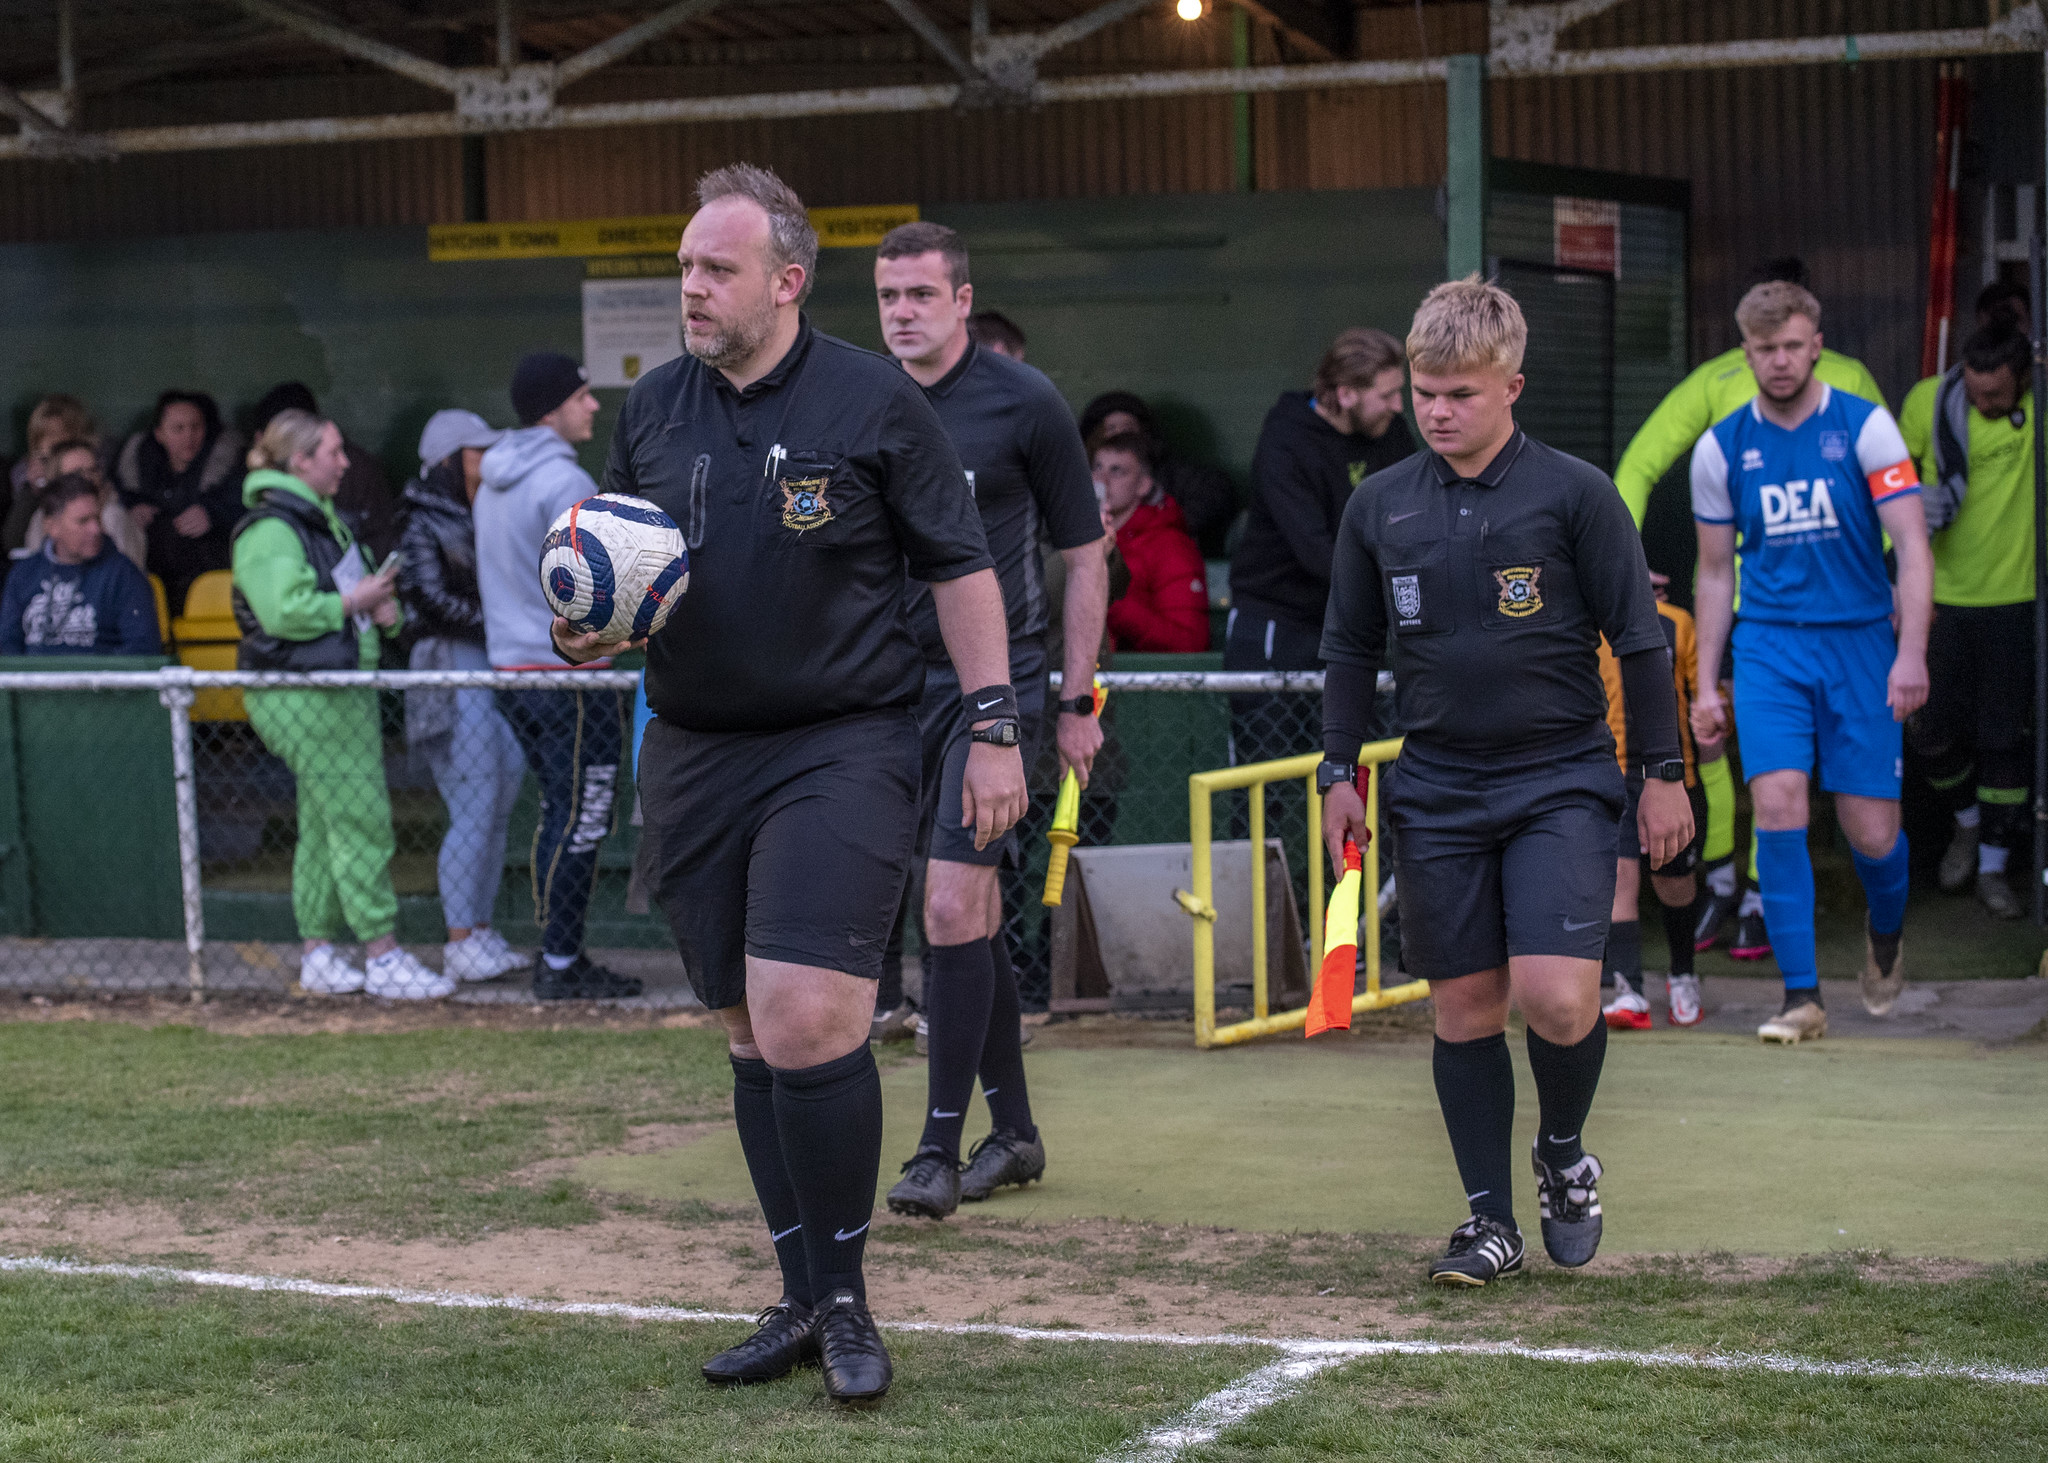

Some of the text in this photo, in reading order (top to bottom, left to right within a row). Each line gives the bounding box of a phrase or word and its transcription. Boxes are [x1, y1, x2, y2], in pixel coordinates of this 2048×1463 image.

[509, 231, 559, 247] TOWN
[1883, 467, 1904, 488] C
[1760, 478, 1839, 528] DEA
